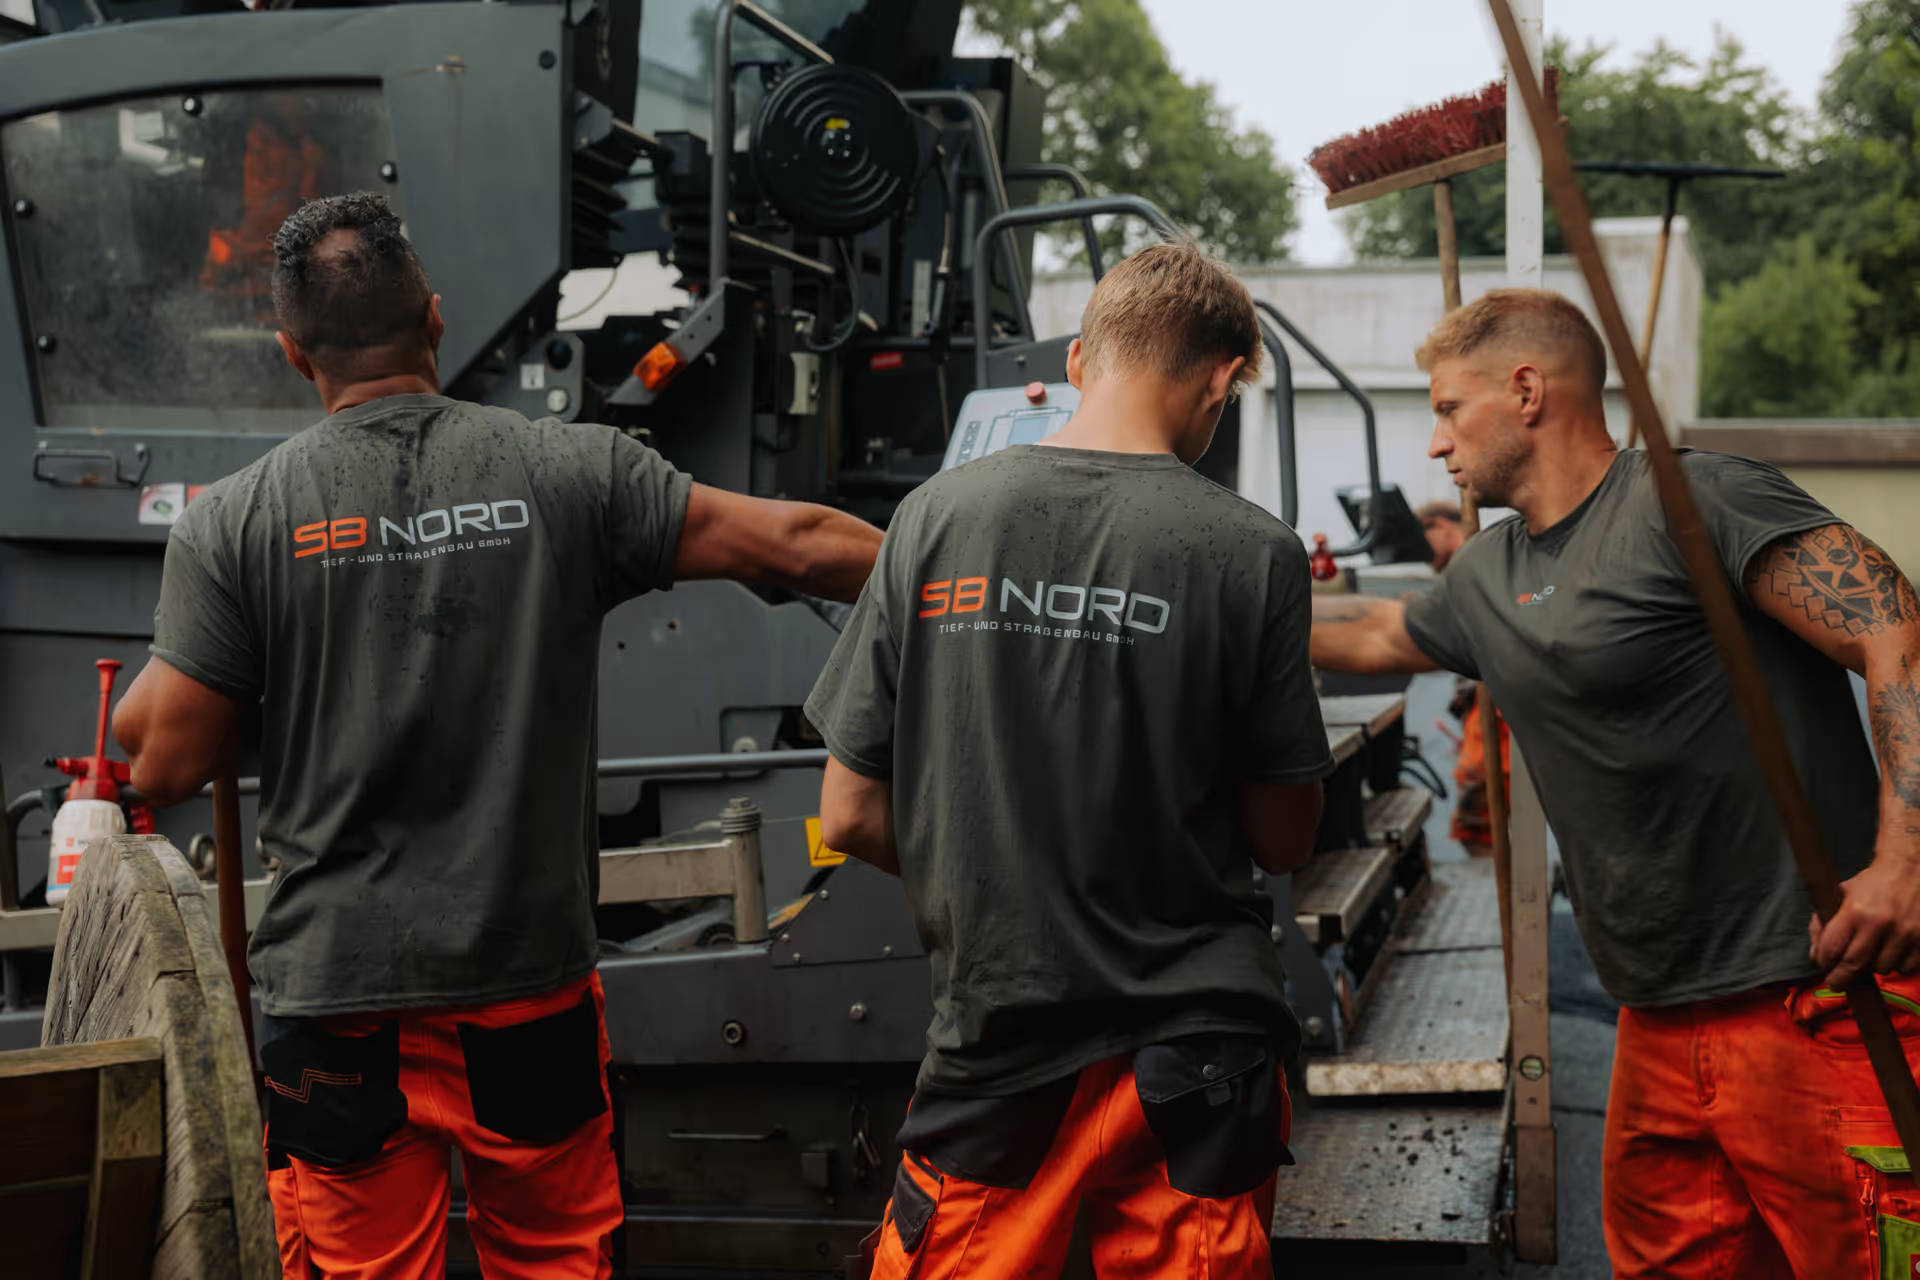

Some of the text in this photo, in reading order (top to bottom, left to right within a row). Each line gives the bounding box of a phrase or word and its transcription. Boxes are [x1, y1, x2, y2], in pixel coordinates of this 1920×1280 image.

[293, 499, 530, 559] SB NORD
[919, 576, 1170, 634] SB NORD
